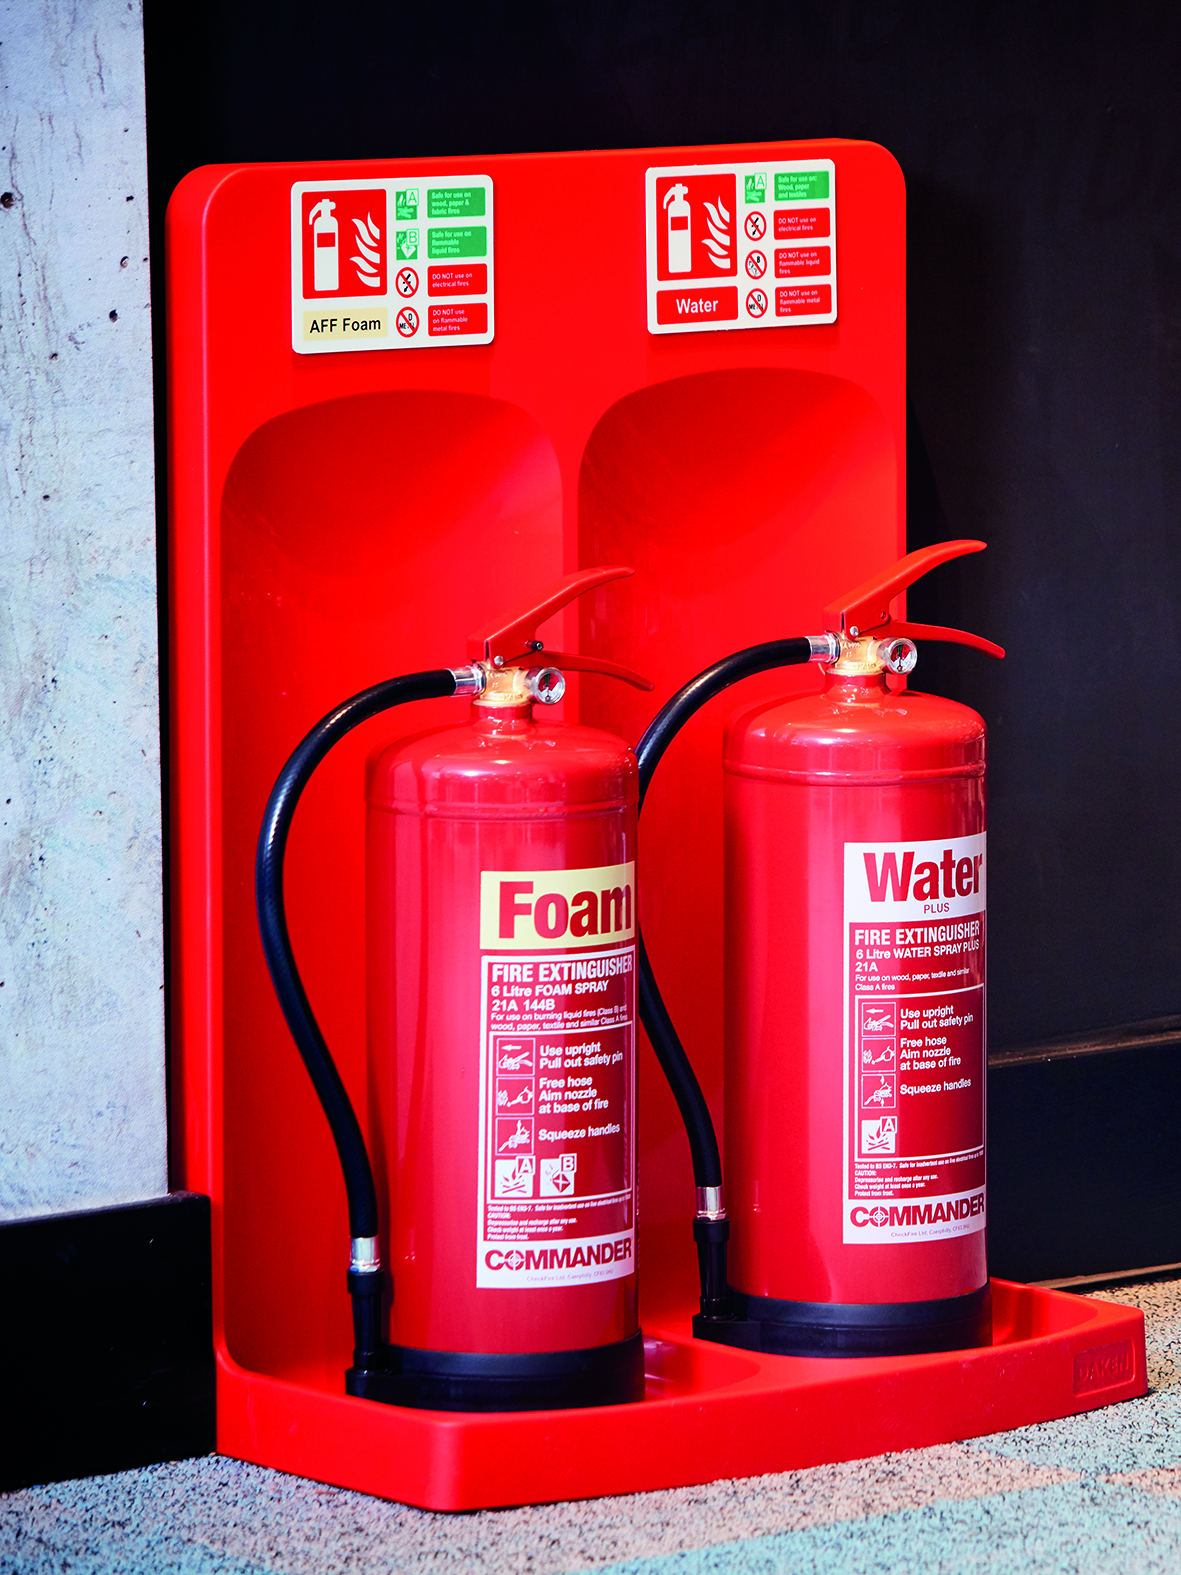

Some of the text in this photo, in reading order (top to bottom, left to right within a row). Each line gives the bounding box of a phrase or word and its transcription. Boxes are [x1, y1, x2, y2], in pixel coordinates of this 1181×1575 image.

[756, 175, 766, 187] A
[408, 191, 417, 204] A
[409, 231, 417, 243] B
[779, 258, 820, 267] flammable liquid
[432, 280, 456, 288] electrical
[676, 298, 719, 314] Water
[310, 317, 381, 333] AFF Foam
[863, 849, 983, 902] Water
[499, 881, 632, 939] Foam
[923, 902, 950, 914] PLUS
[854, 920, 980, 946] FIRE EXTINGUISHER
[856, 939, 980, 959] 6 Litre WATER SPRAY PLUS
[491, 954, 633, 983] FIRE EXTINGUISHER
[855, 961, 879, 972] 21A
[855, 974, 867, 982] For
[891, 972, 912, 981] wood,
[912, 972, 931, 982] paper,
[931, 969, 947, 979] textile
[947, 968, 957, 977] and
[957, 967, 970, 976] similar
[491, 980, 609, 997] 6 Litre FOAM SPRAY
[855, 983, 896, 991] Class A fires
[491, 998, 555, 1012] 21A 144B
[491, 1012, 505, 1021] For
[506, 1013, 520, 1021] use
[534, 1010, 563, 1022] burning
[564, 1009, 581, 1020] liquid
[582, 1008, 596, 1017] fires
[620, 1003, 628, 1012] and
[900, 1005, 954, 1020] Use upright
[542, 1020, 565, 1030] textile
[565, 1018, 579, 1028] and
[580, 1017, 600, 1027] similar
[601, 1015, 615, 1025] Class
[615, 1014, 620, 1023] A
[900, 1013, 974, 1031] Pull out safety pin
[540, 1041, 602, 1057] Use upright
[900, 1036, 947, 1049] Free hose
[539, 1050, 624, 1069] Pull out safety pin
[900, 1046, 951, 1060] Aim nozzle
[900, 1056, 962, 1071] at base of fire
[539, 1075, 593, 1089] Free hose
[900, 1078, 972, 1097] Squeeze handles
[539, 1086, 598, 1102] Aim nozzle
[538, 1098, 610, 1115] at base of fire
[538, 1122, 621, 1143] Squeeze handles
[883, 1118, 895, 1132] A
[519, 1158, 533, 1173] A
[563, 1157, 574, 1171] B
[850, 1192, 985, 1228] COMMANDER
[485, 1237, 632, 1271] COMMANDER
